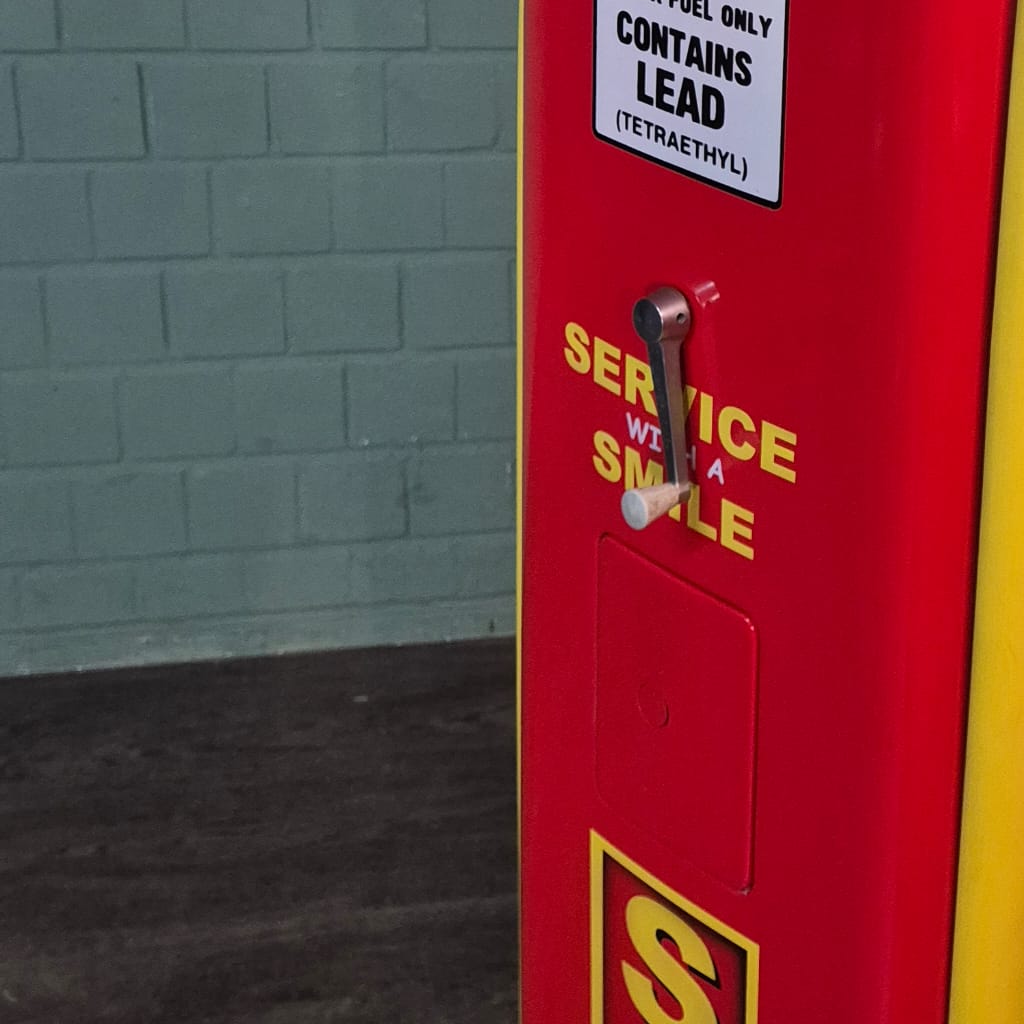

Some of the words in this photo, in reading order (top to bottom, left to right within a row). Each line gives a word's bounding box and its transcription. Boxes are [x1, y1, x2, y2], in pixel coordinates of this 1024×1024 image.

[616, 10, 753, 87] CONTAINS
[721, 4, 773, 39] ONLY
[636, 60, 726, 131] LEAD
[615, 109, 749, 182] (TETRAETHYL)
[626, 412, 696, 470] WIH
[707, 458, 725, 485] A
